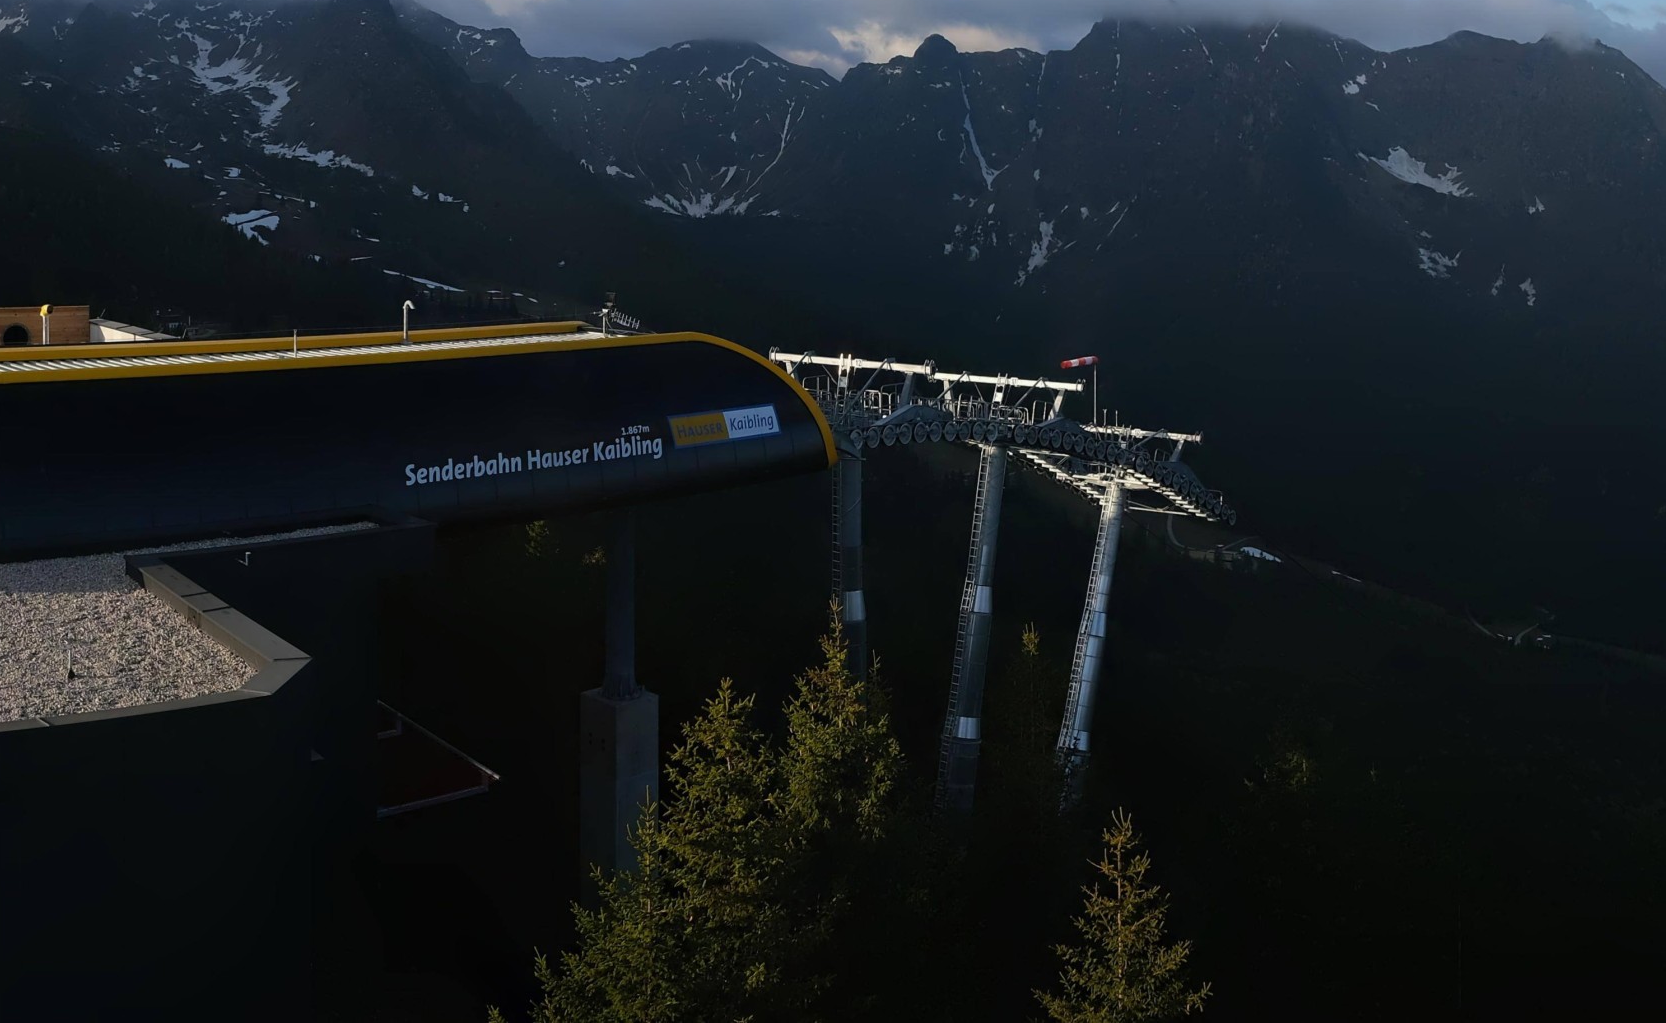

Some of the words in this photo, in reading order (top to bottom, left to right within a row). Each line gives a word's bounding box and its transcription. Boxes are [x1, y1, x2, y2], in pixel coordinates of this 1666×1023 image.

[620, 424, 651, 437] 1.867m
[675, 422, 724, 439] HAUSER
[728, 413, 775, 431] Kaibling
[404, 451, 523, 488] Senderbahn
[526, 447, 590, 471] Hauser
[592, 435, 663, 462] Kaibling
